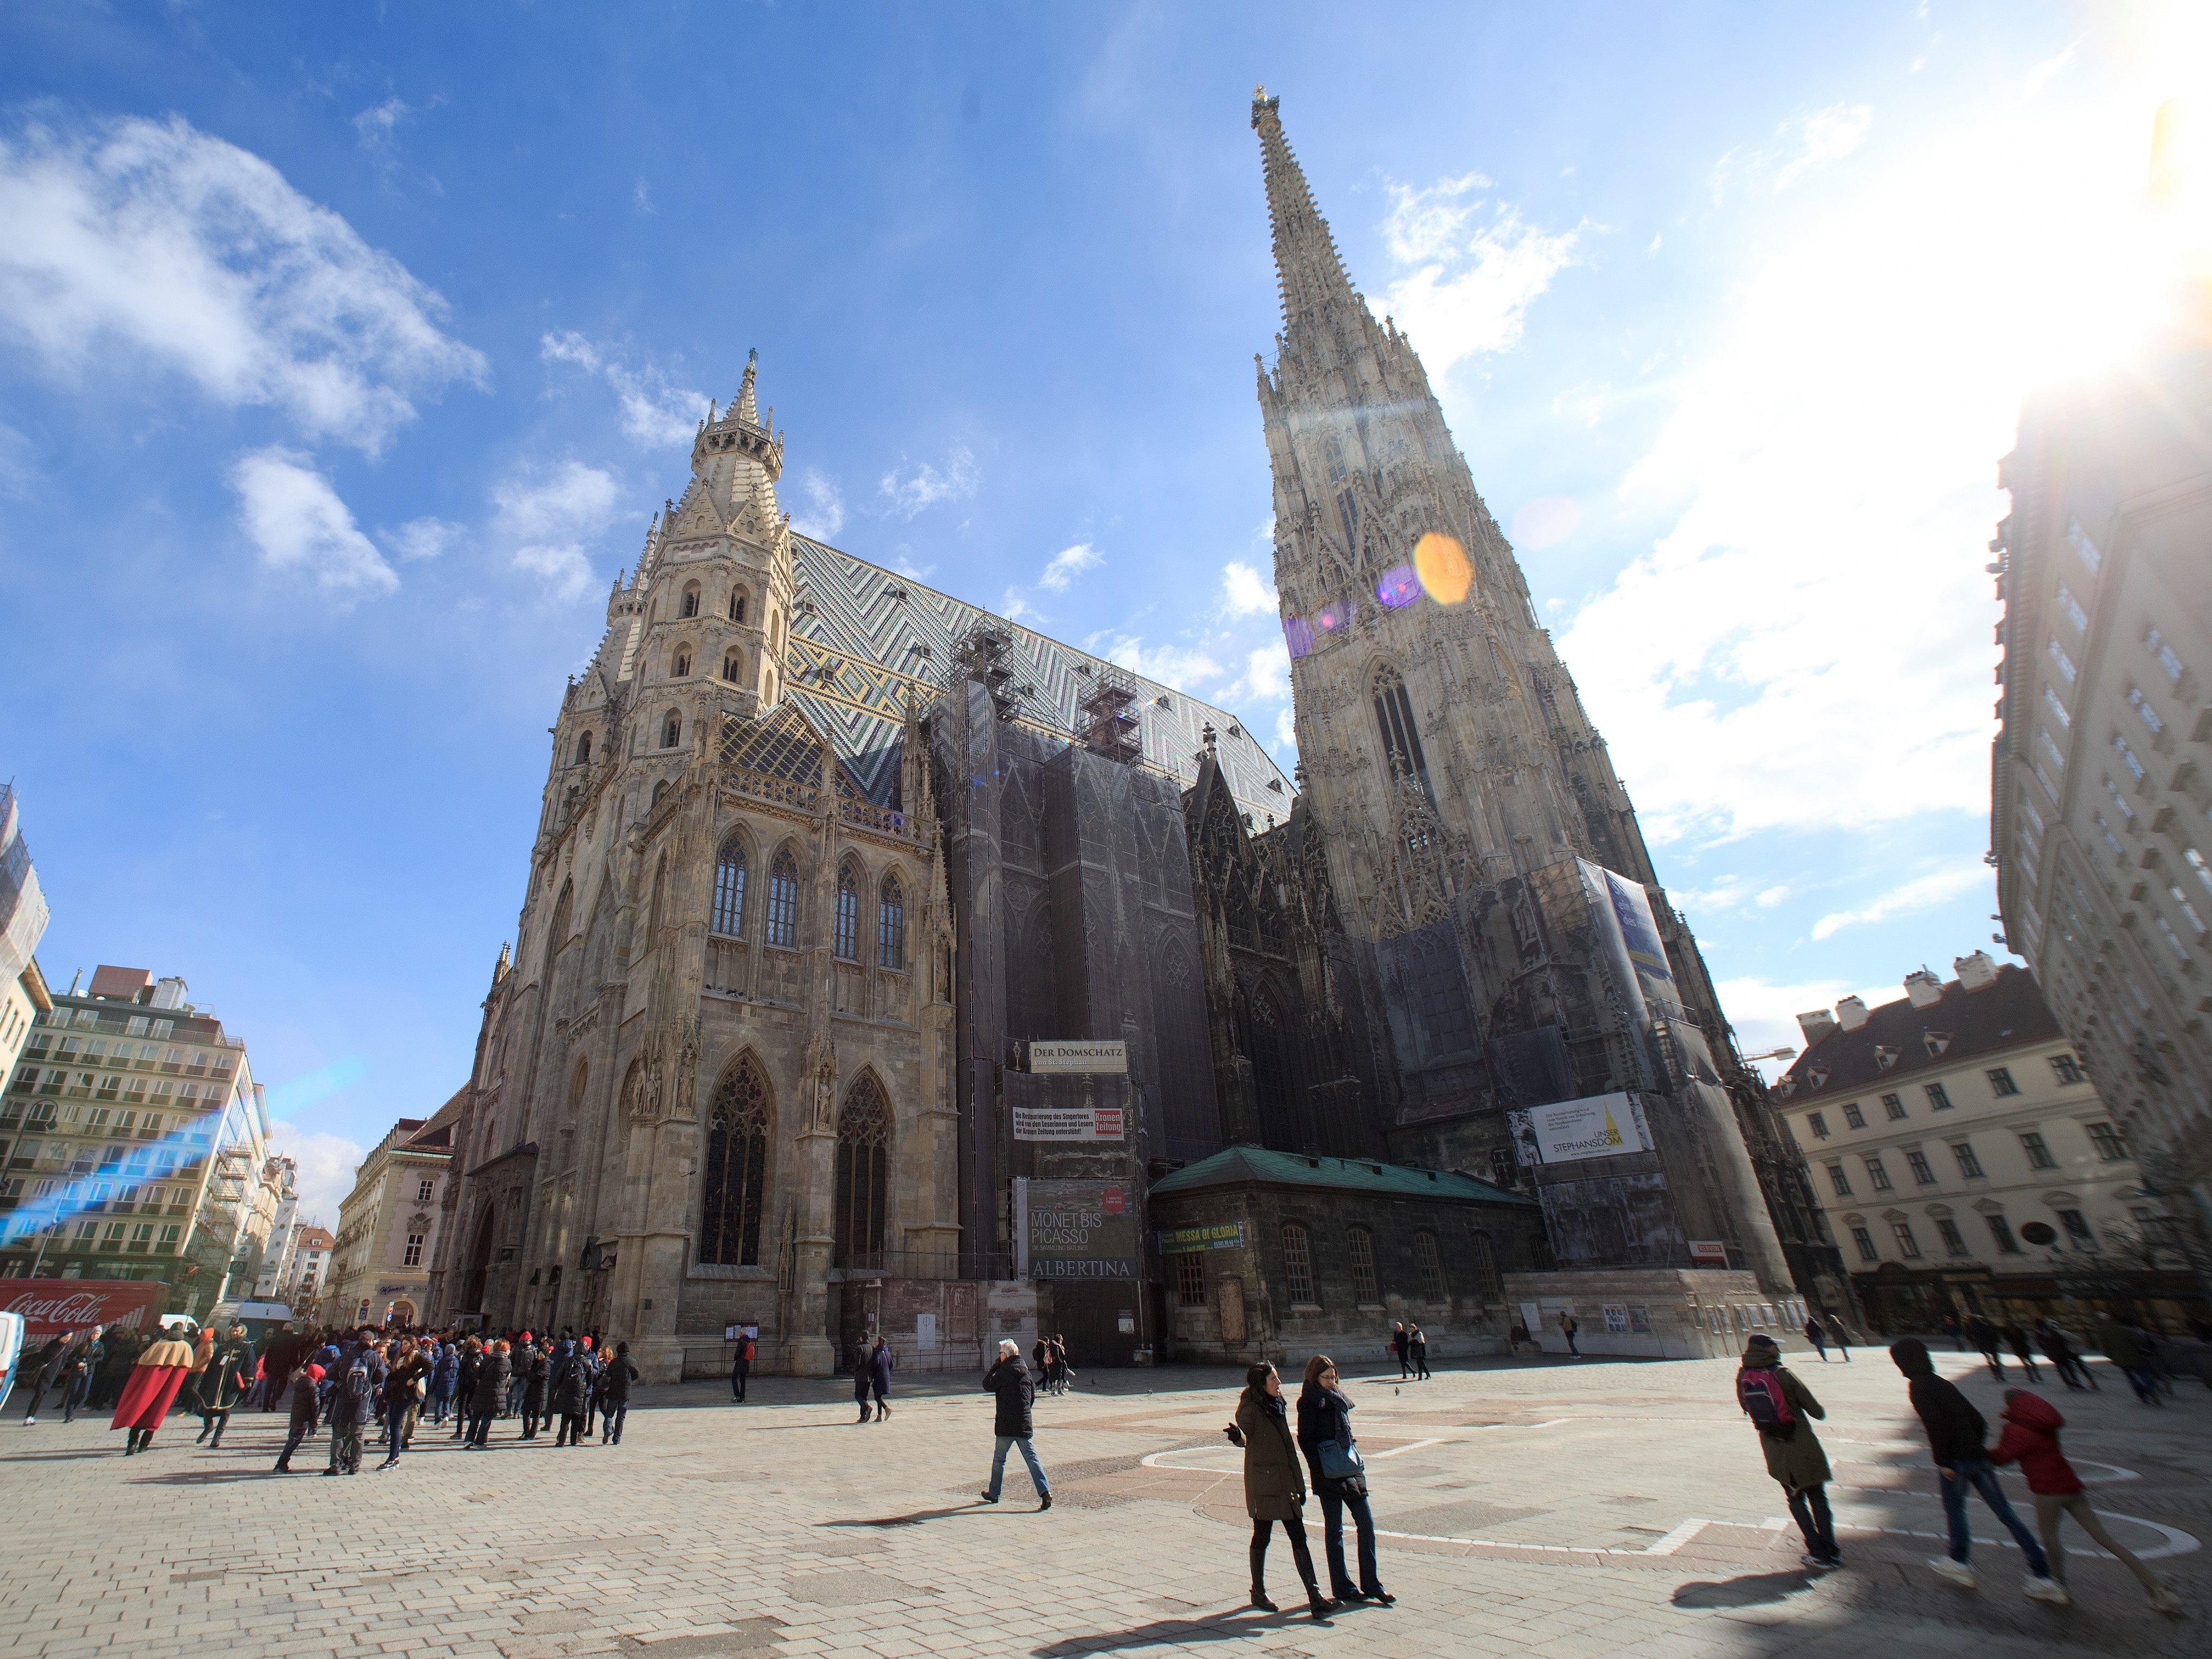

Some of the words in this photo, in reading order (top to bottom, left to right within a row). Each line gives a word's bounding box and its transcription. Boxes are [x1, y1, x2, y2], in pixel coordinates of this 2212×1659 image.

[1034, 1048, 1055, 1057] DER
[1058, 1048, 1122, 1057] DOMSCHATZ
[1022, 1112, 1052, 1120] Restaurierung
[1063, 1113, 1089, 1121] Singertores
[1095, 1113, 1120, 1122] Kronen
[1096, 1122, 1121, 1132] Zeitung
[1594, 1129, 1618, 1137] UNSER
[1553, 1137, 1623, 1152] STEPHANSDOM
[1031, 1212, 1078, 1228] MONET
[1081, 1212, 1102, 1228] BIS
[1032, 1228, 1088, 1244] PICASSO
[1175, 1230, 1200, 1242] MESSA
[1202, 1229, 1210, 1240] DI
[1212, 1225, 1238, 1239] GLORIA
[1032, 1260, 1131, 1276] ALBERTINA
